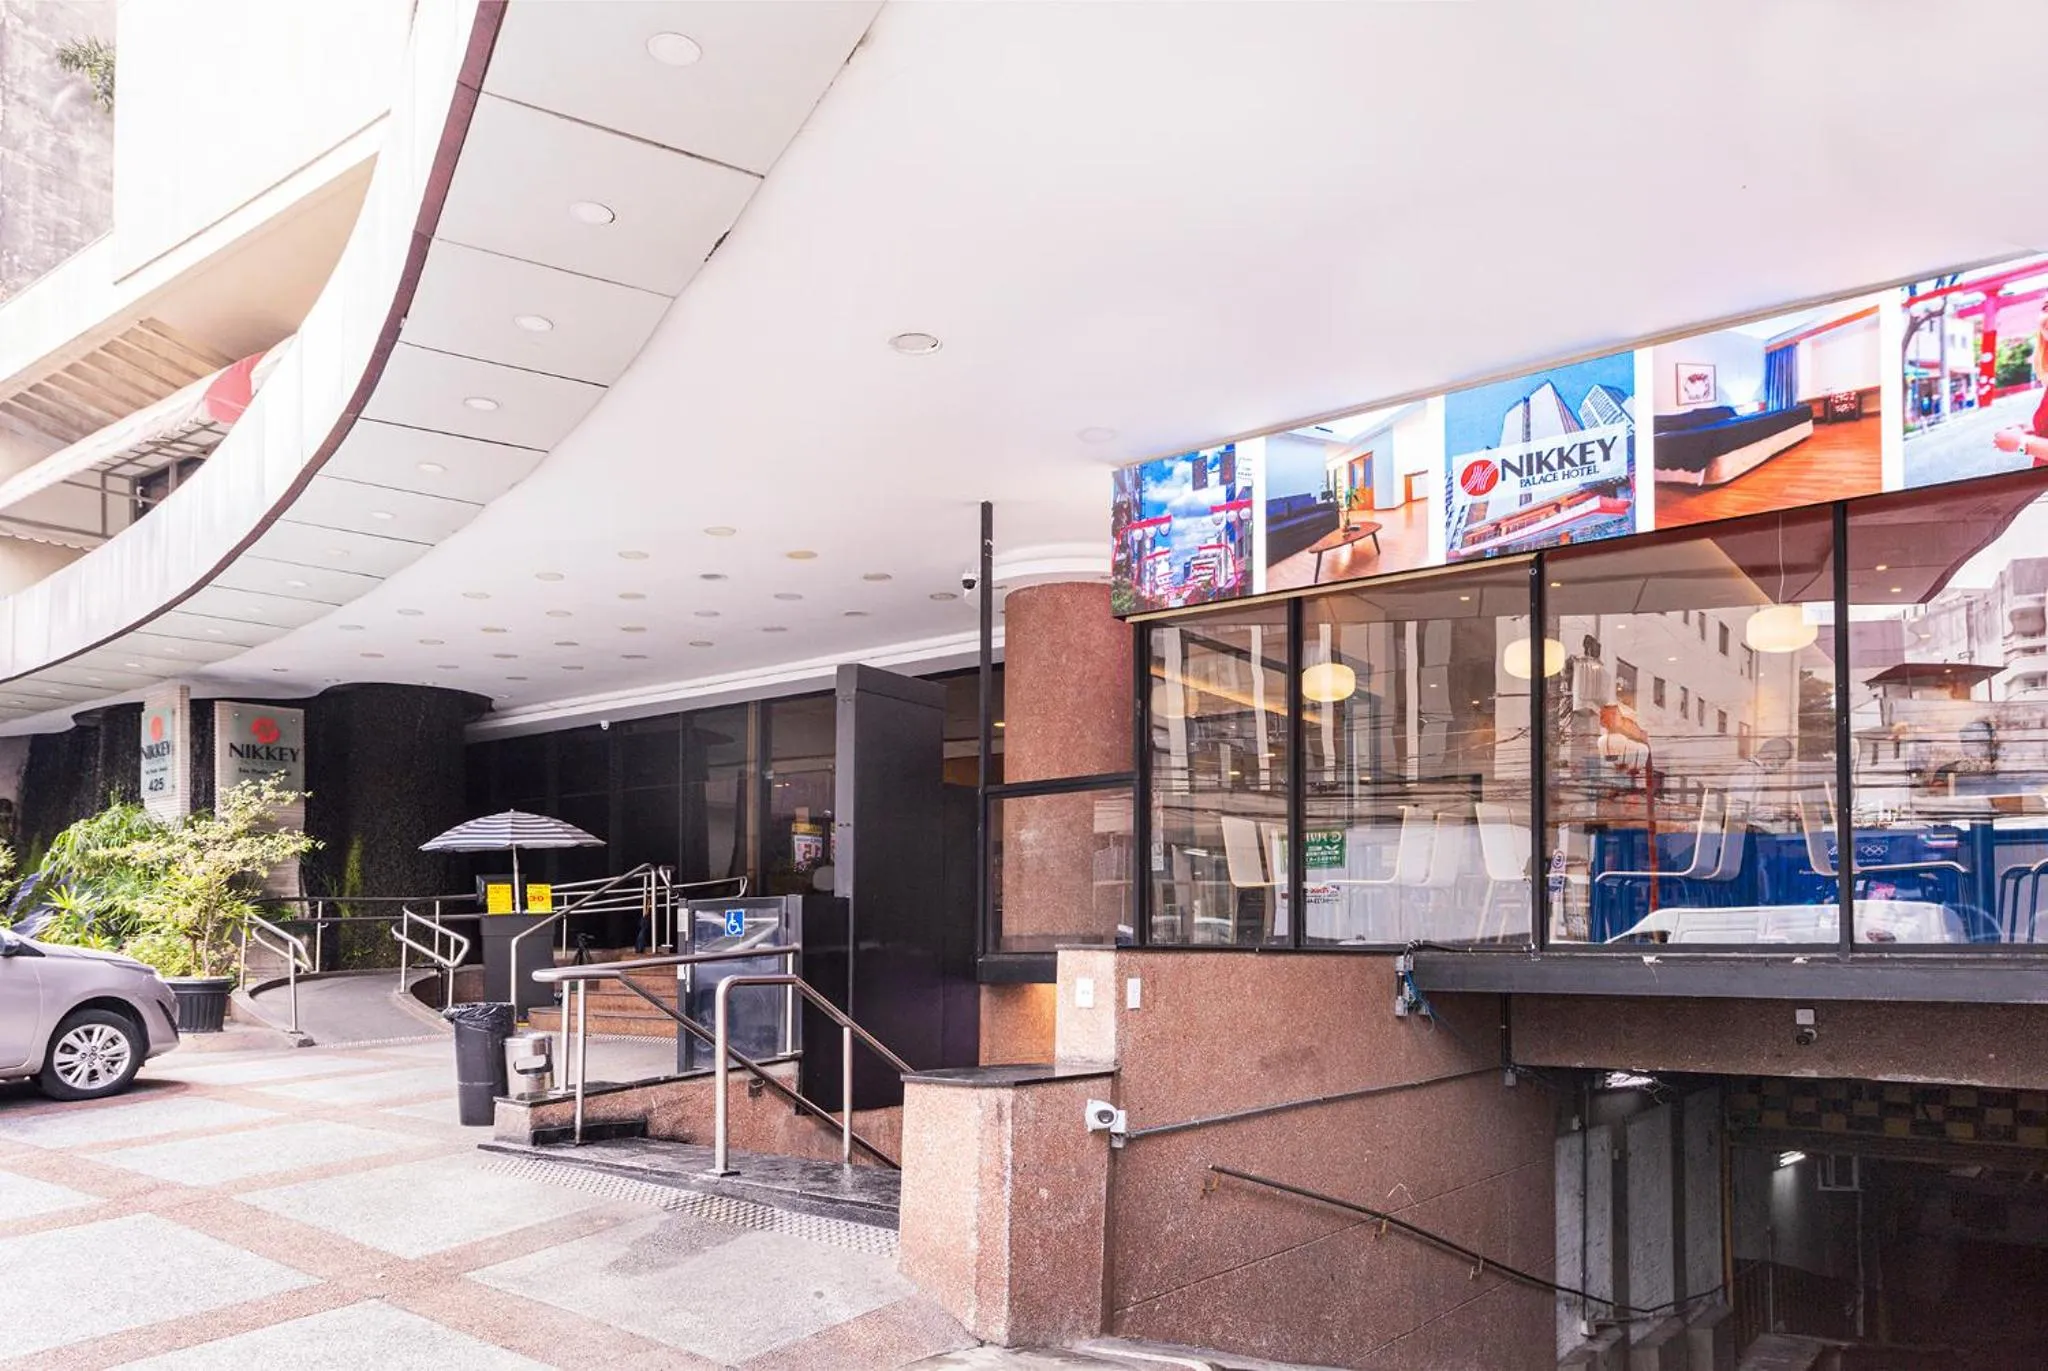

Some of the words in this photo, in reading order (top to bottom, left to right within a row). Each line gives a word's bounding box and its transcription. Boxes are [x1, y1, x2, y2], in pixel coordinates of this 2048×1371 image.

[1500, 435, 1618, 482] NIKKEY
[1519, 473, 1559, 488] PALACE
[1561, 465, 1600, 480] HOTEL
[229, 742, 299, 762] NIKKEY
[148, 777, 164, 791] 425
